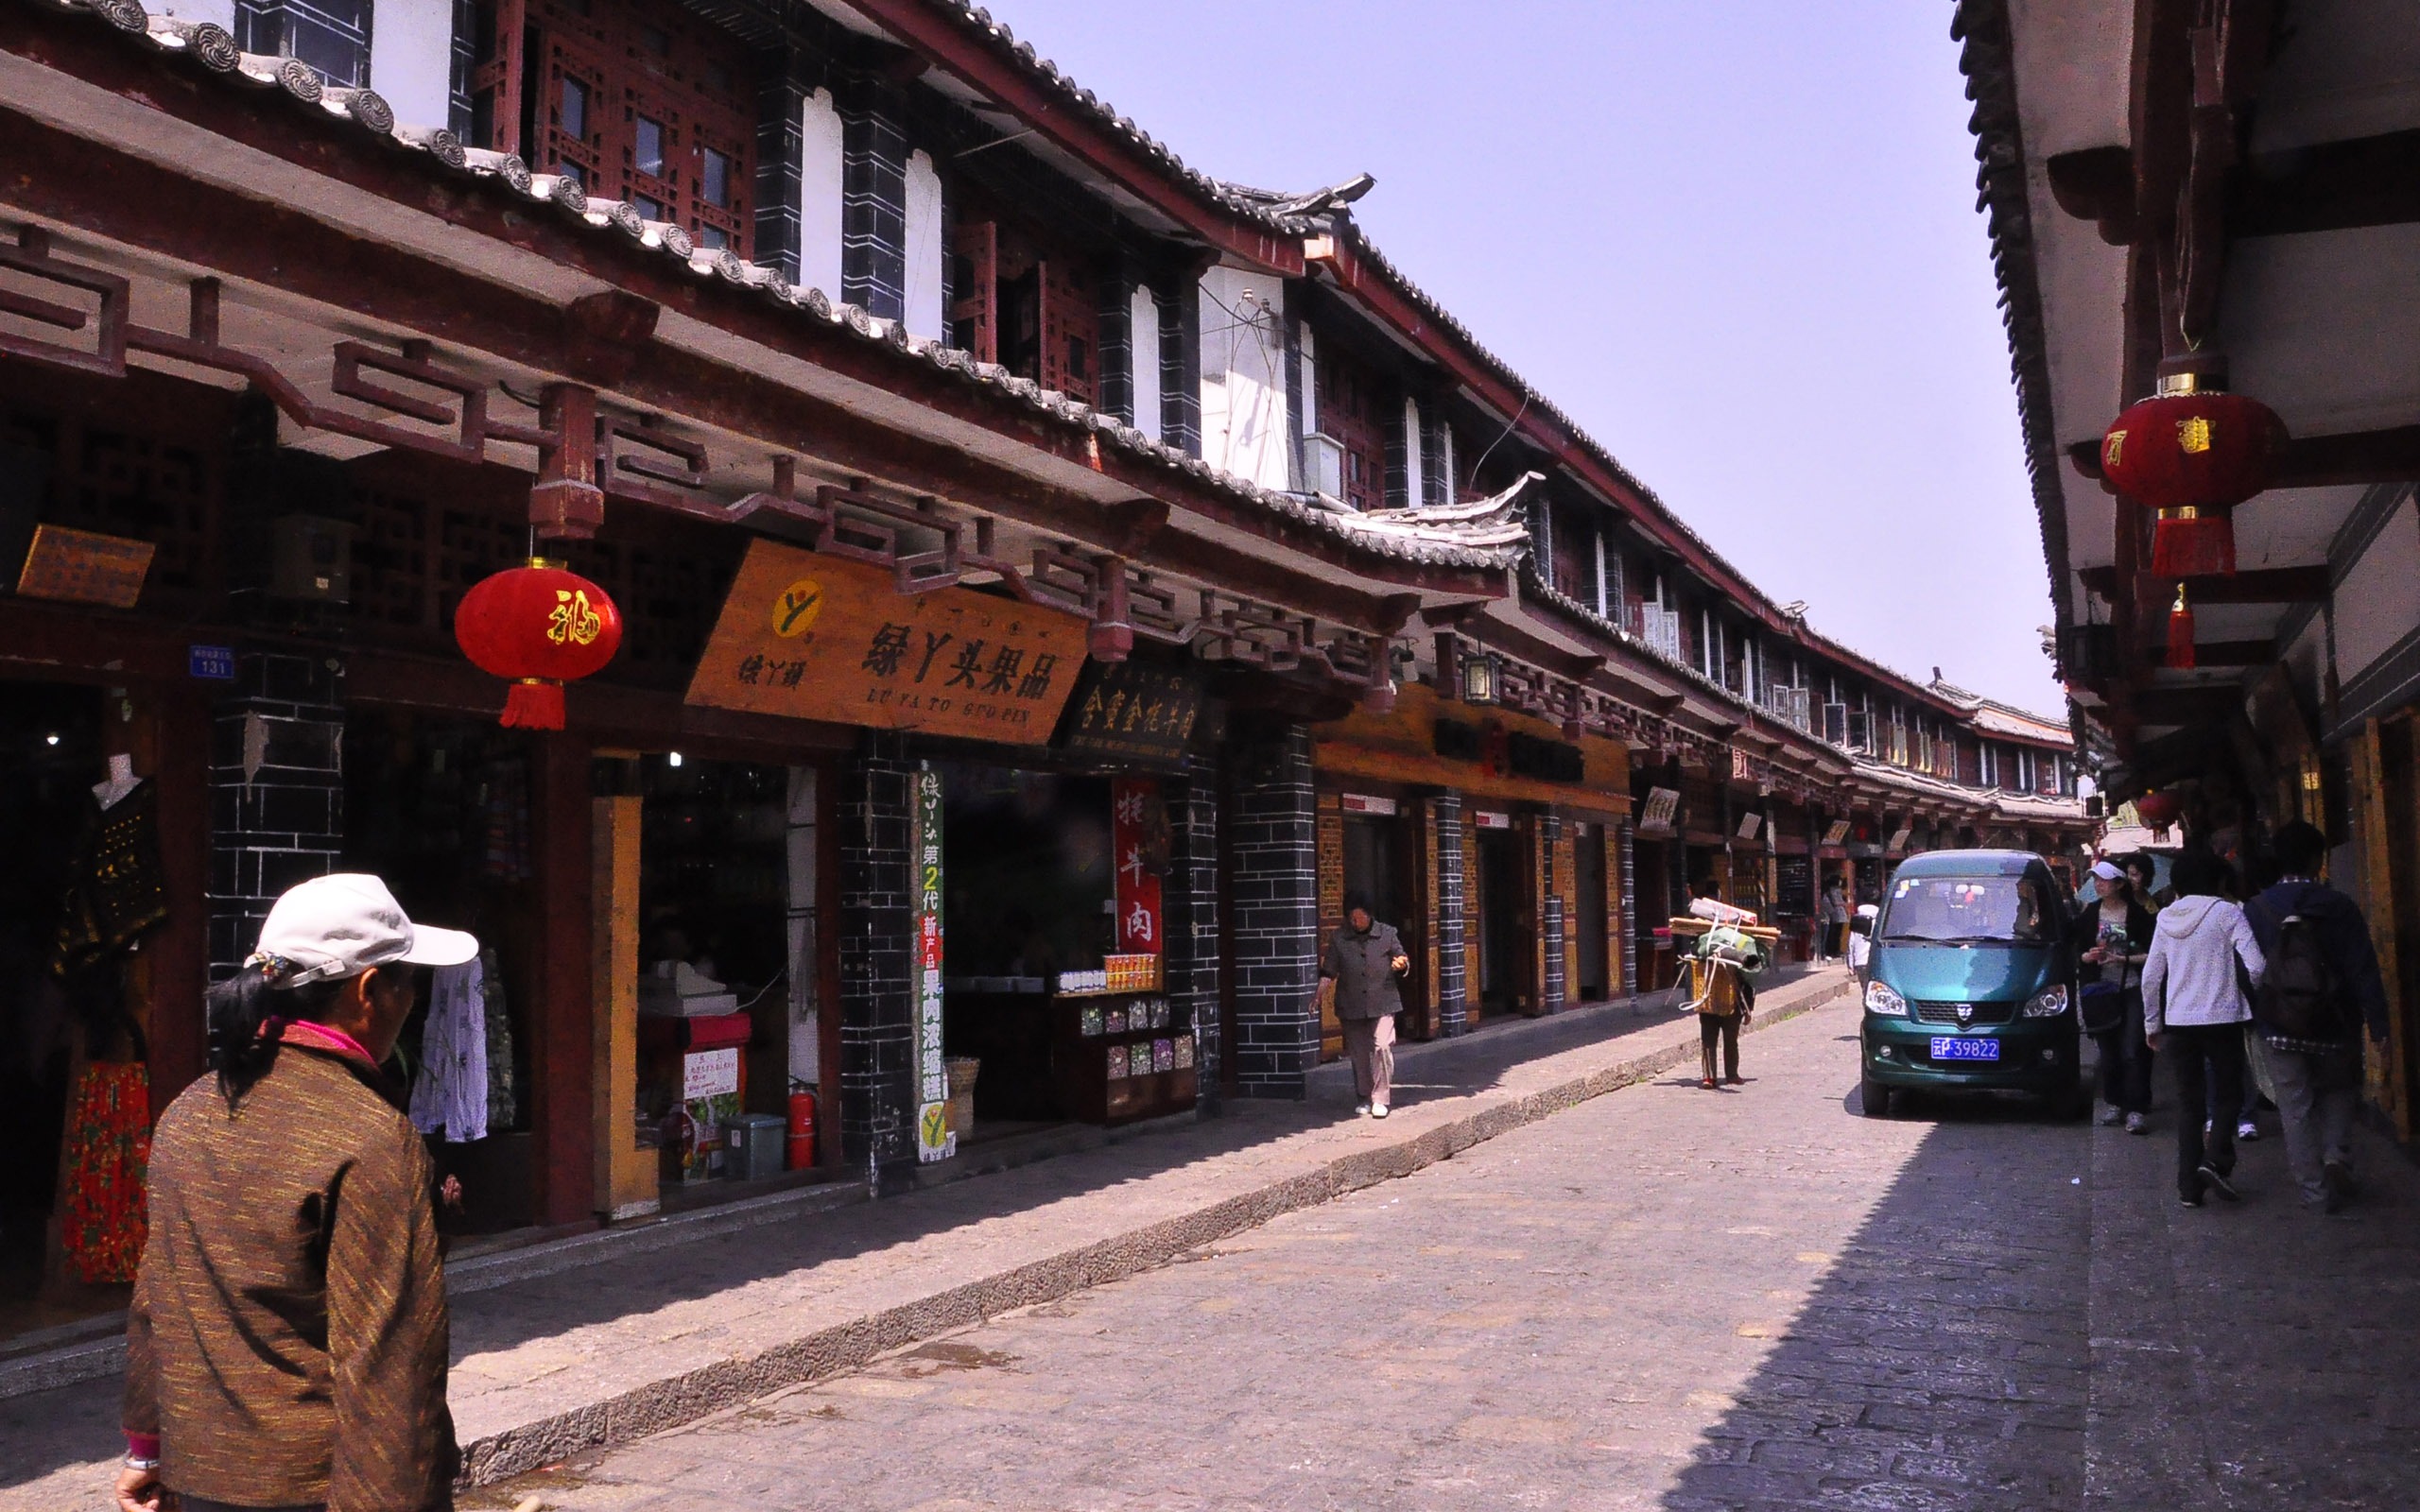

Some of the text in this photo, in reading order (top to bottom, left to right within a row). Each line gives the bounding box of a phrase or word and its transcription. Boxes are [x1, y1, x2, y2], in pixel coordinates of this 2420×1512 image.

[546, 590, 601, 645] 福
[201, 661, 225, 675] 131
[866, 688, 891, 704] LU
[899, 693, 919, 709] YA
[928, 697, 951, 712] TO
